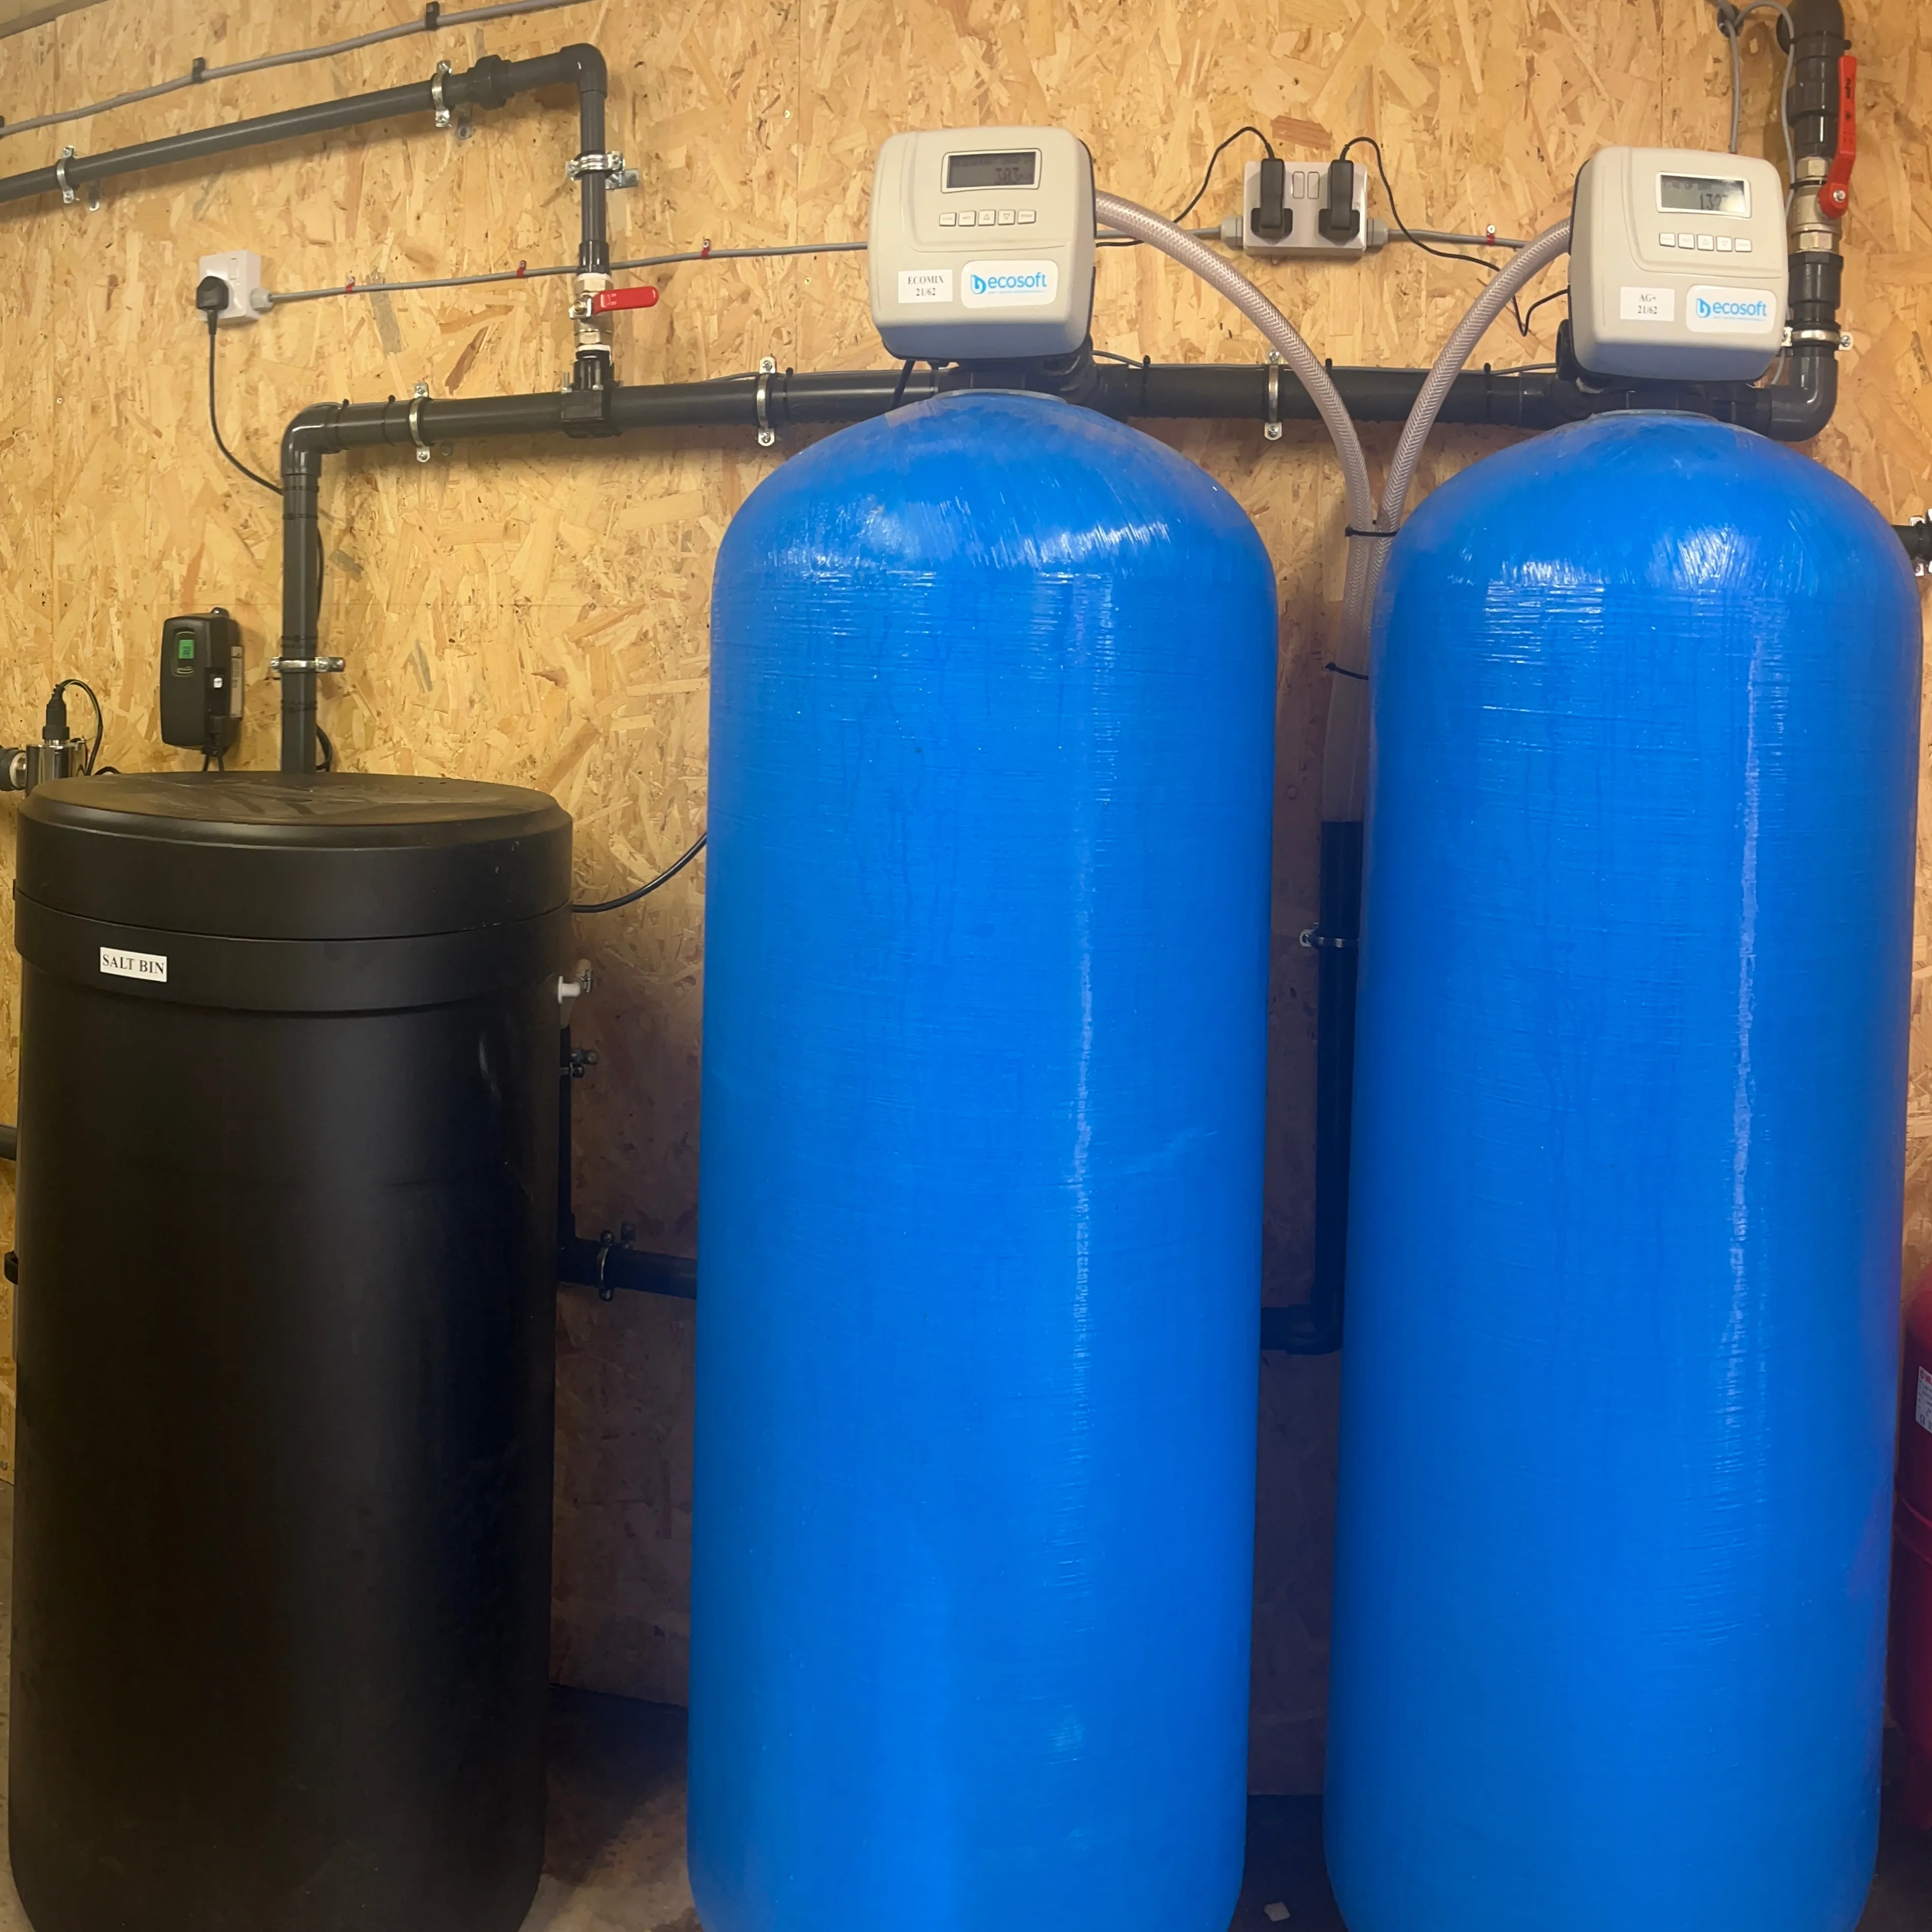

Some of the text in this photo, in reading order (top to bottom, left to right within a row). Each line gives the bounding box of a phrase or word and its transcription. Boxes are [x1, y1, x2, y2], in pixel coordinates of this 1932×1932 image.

[908, 275, 944, 284] ECOMIX
[988, 272, 1047, 288] ecosoft
[916, 287, 936, 297] 21/62
[1639, 294, 1657, 302] AG+
[1637, 305, 1658, 314] 21/62
[1713, 301, 1767, 316] ecosoft
[103, 954, 164, 974] SALT BIN
